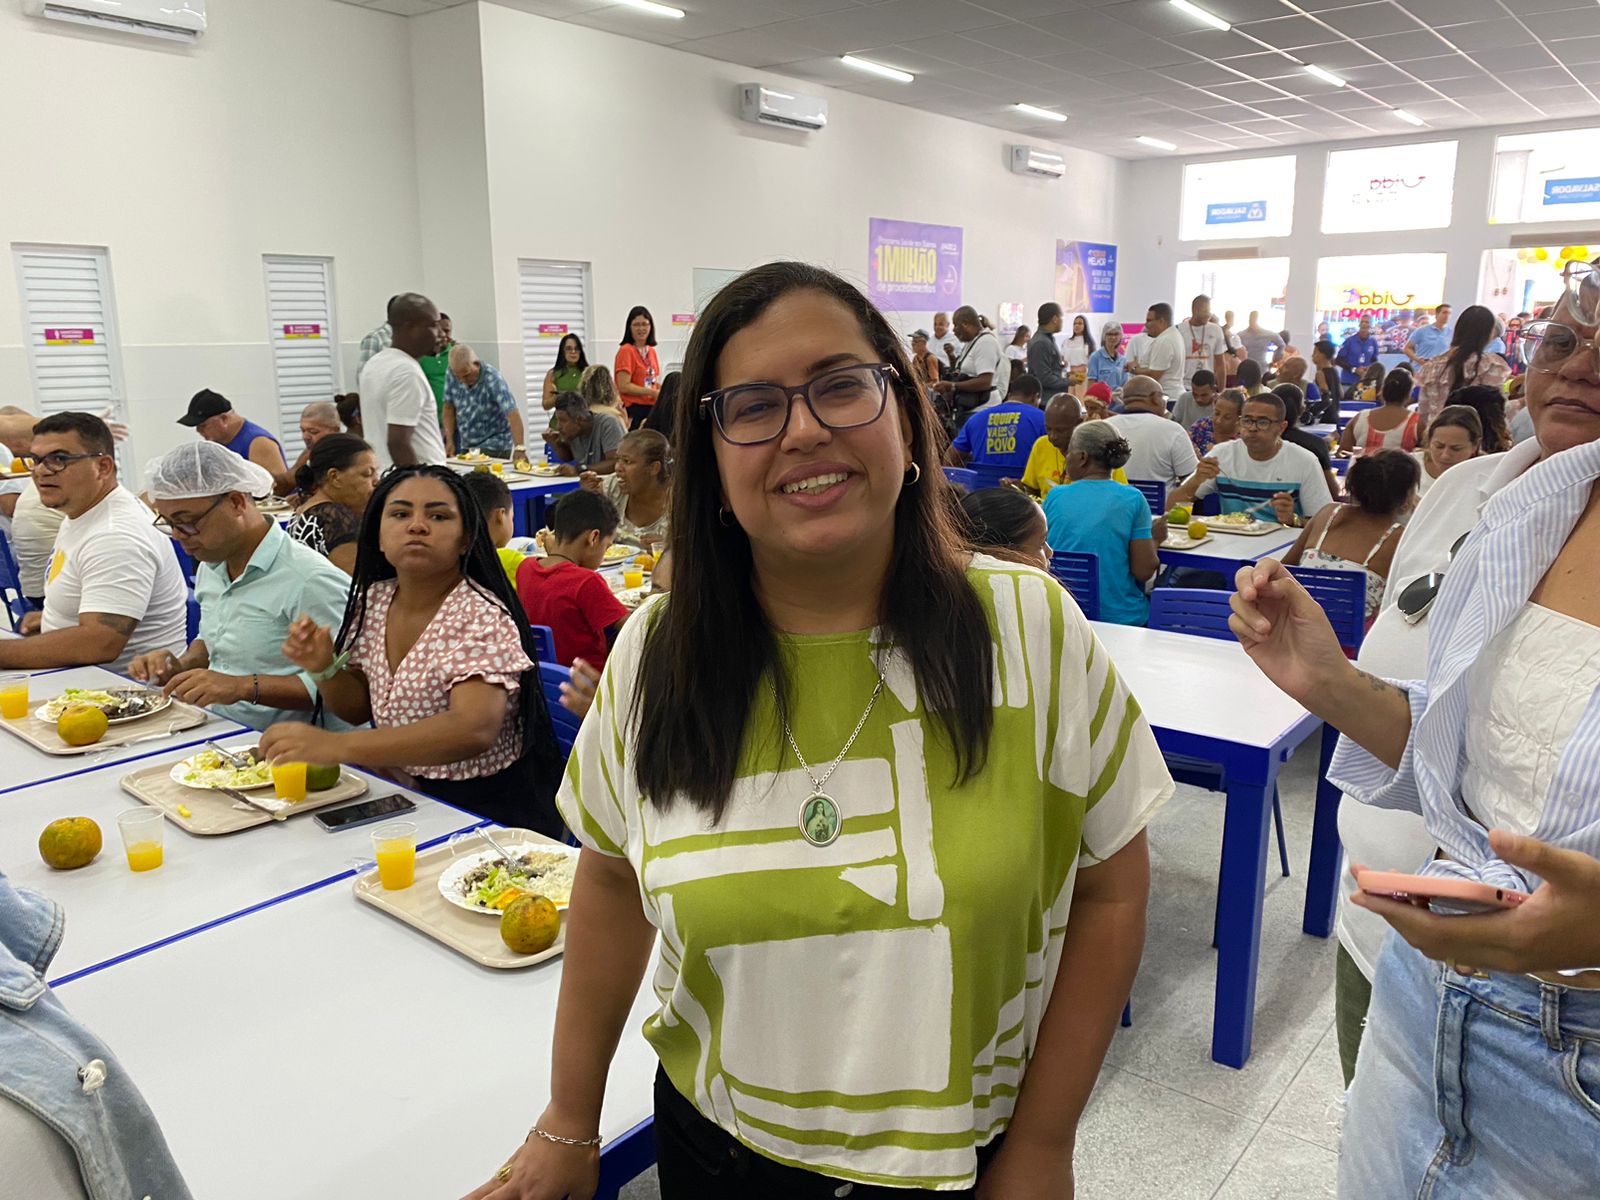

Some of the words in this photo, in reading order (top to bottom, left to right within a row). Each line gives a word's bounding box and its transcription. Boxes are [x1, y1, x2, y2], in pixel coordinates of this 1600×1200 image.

[875, 245, 883, 282] 1
[885, 245, 937, 284] MILHÃO
[988, 412, 1021, 425] EQUIPE
[987, 437, 1016, 453] POVO
